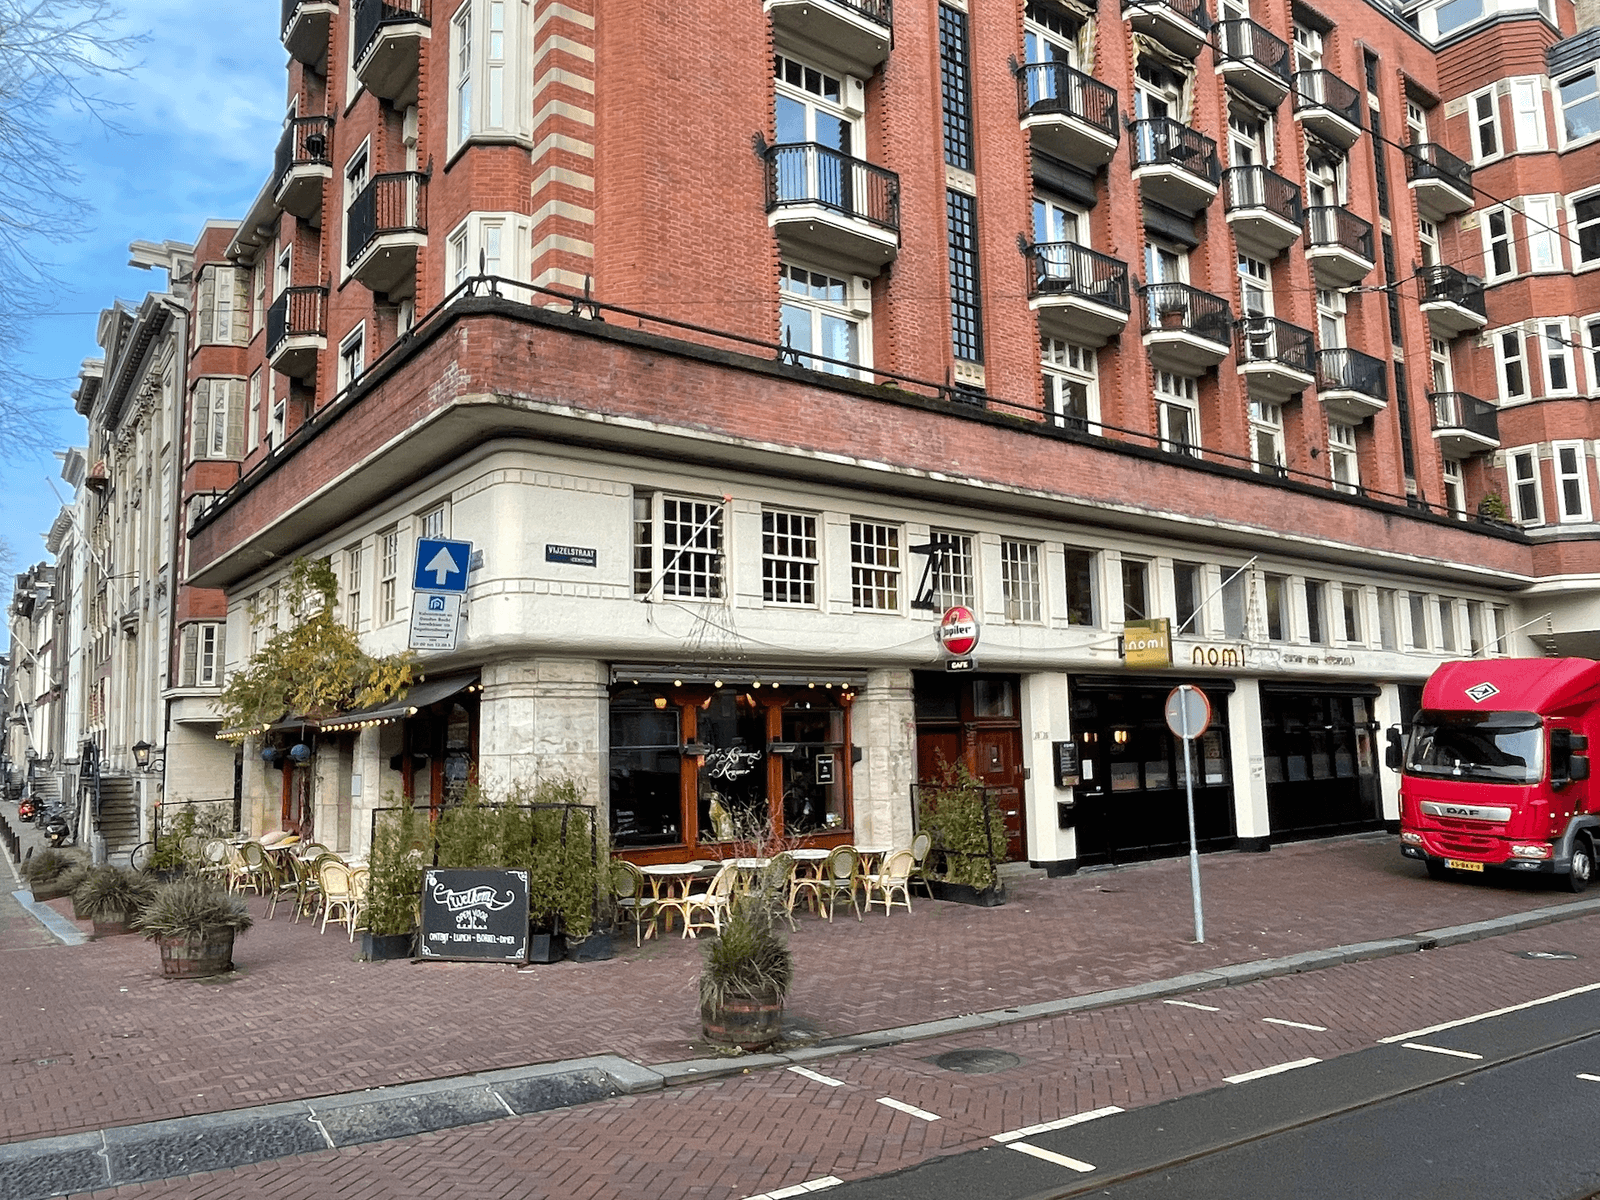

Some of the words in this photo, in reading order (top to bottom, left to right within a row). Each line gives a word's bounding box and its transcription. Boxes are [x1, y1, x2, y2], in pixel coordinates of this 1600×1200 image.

[548, 546, 594, 558] VIJZELSTRAAT
[1128, 636, 1163, 650] nomi
[1192, 644, 1245, 667] nomi
[1446, 807, 1479, 816] DAF
[453, 933, 471, 942] LUNCH
[476, 933, 497, 944] BORREL
[499, 935, 515, 944] DINER
